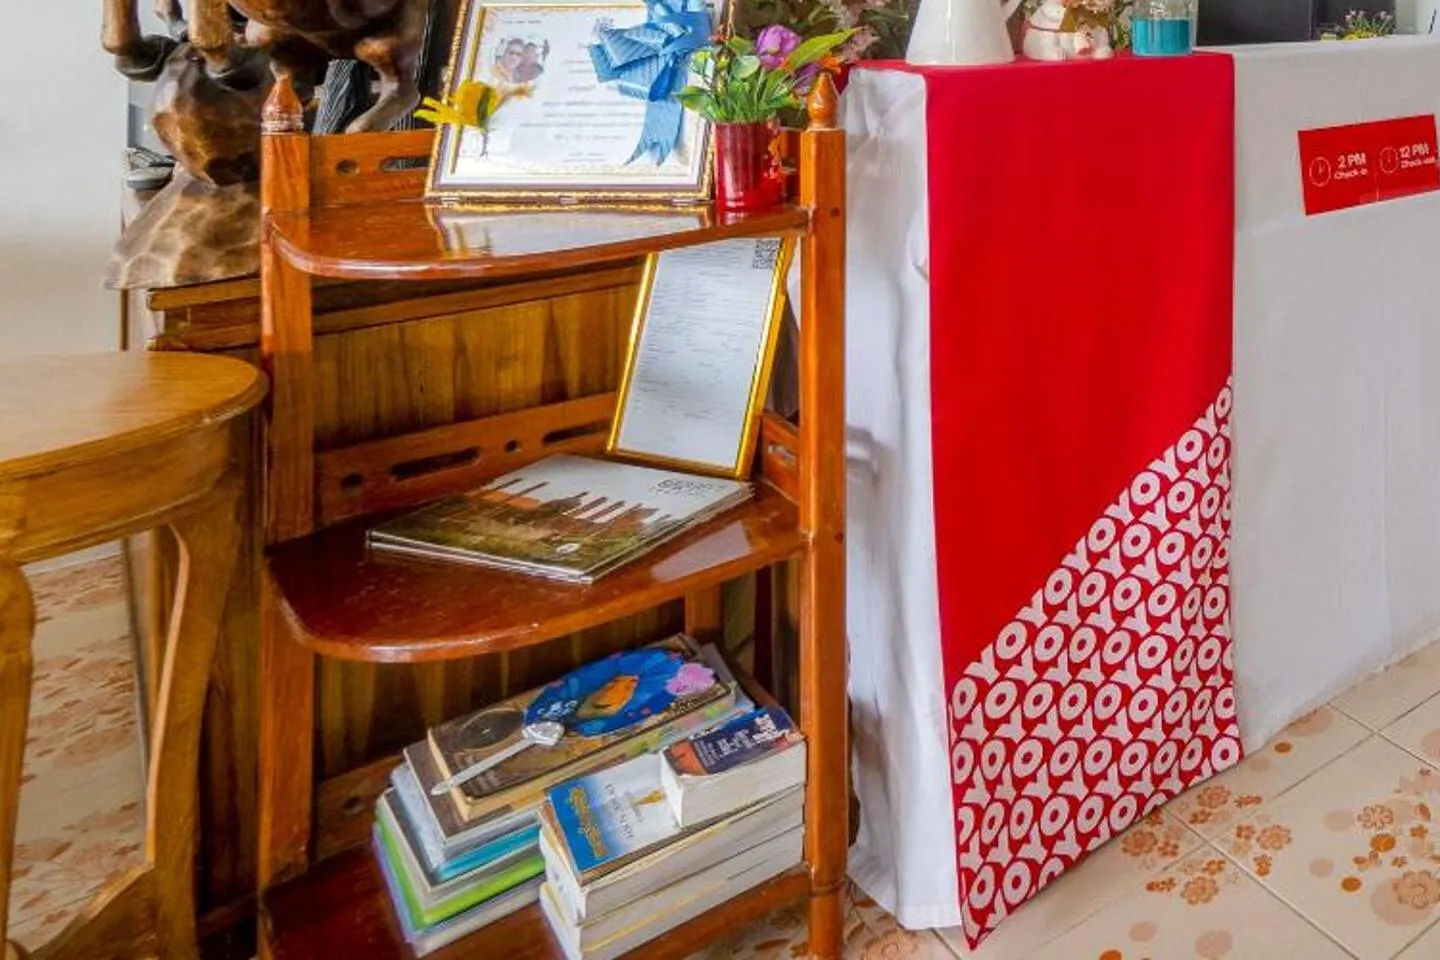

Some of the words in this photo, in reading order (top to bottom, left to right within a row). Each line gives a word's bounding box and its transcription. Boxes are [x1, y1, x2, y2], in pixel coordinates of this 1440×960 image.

[1412, 142, 1430, 155] PM
[1337, 154, 1347, 168] 2
[1348, 152, 1367, 167] PM
